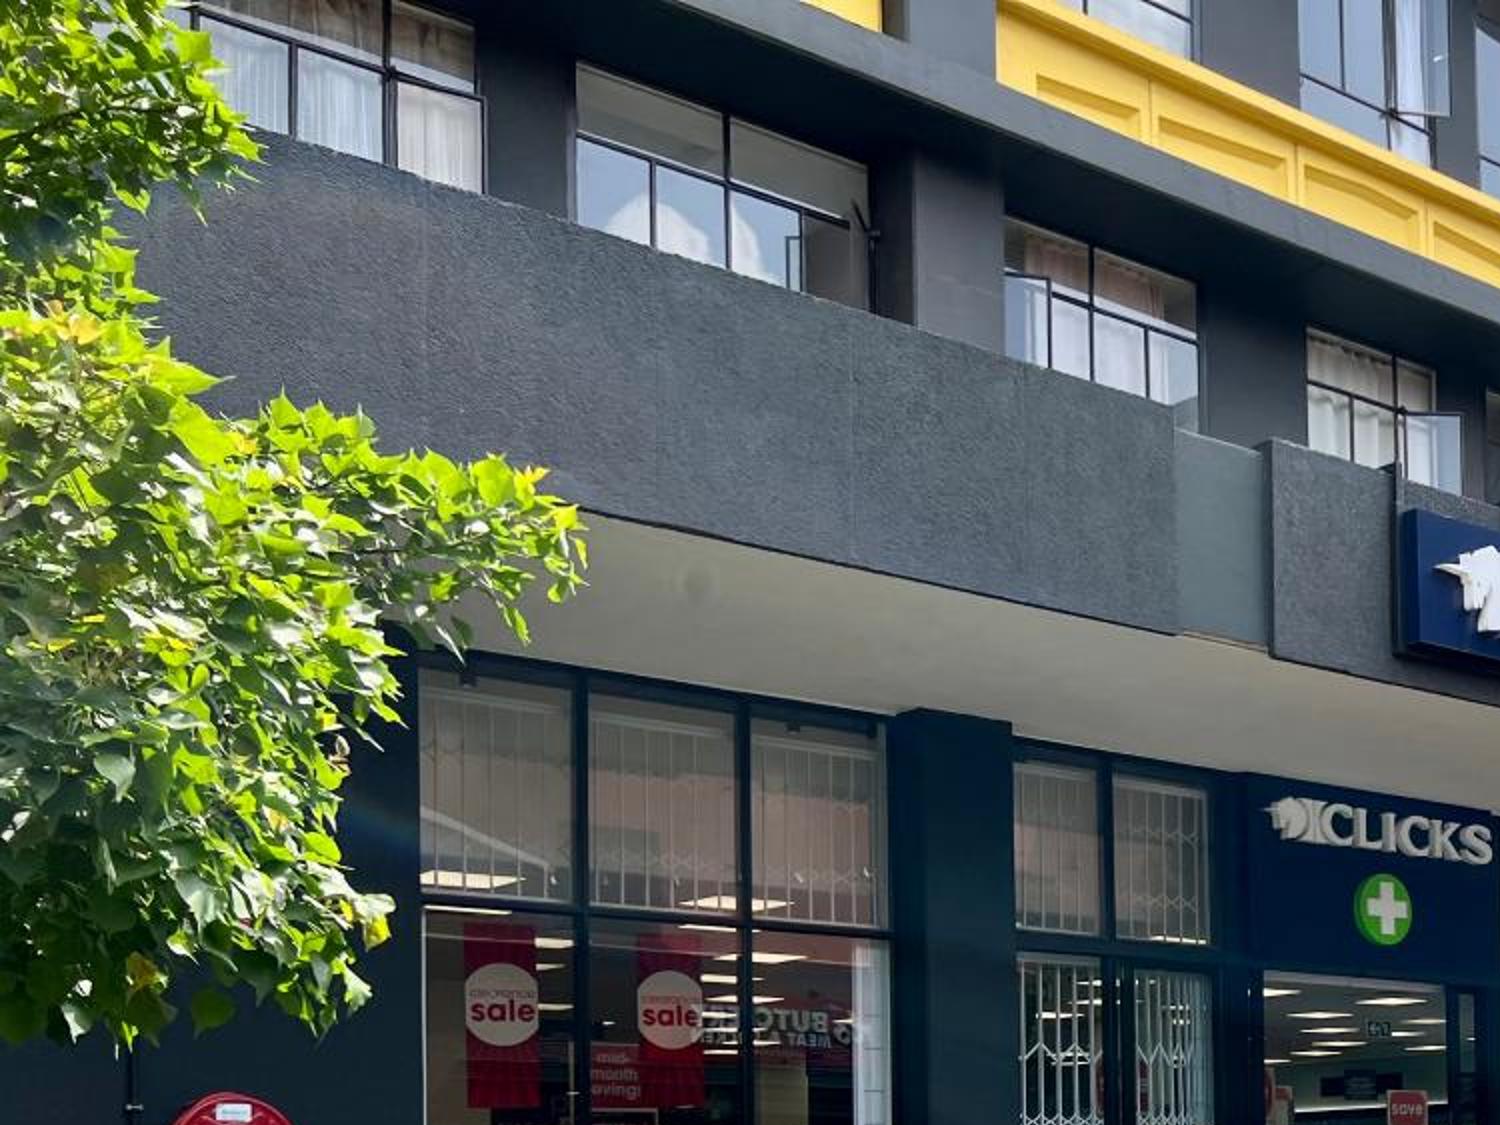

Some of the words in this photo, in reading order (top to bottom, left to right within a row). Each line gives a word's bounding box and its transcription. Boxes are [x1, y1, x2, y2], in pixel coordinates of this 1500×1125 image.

[1320, 802, 1494, 865] CLICKS
[471, 999, 536, 1023] sale
[642, 1005, 698, 1027] sale
